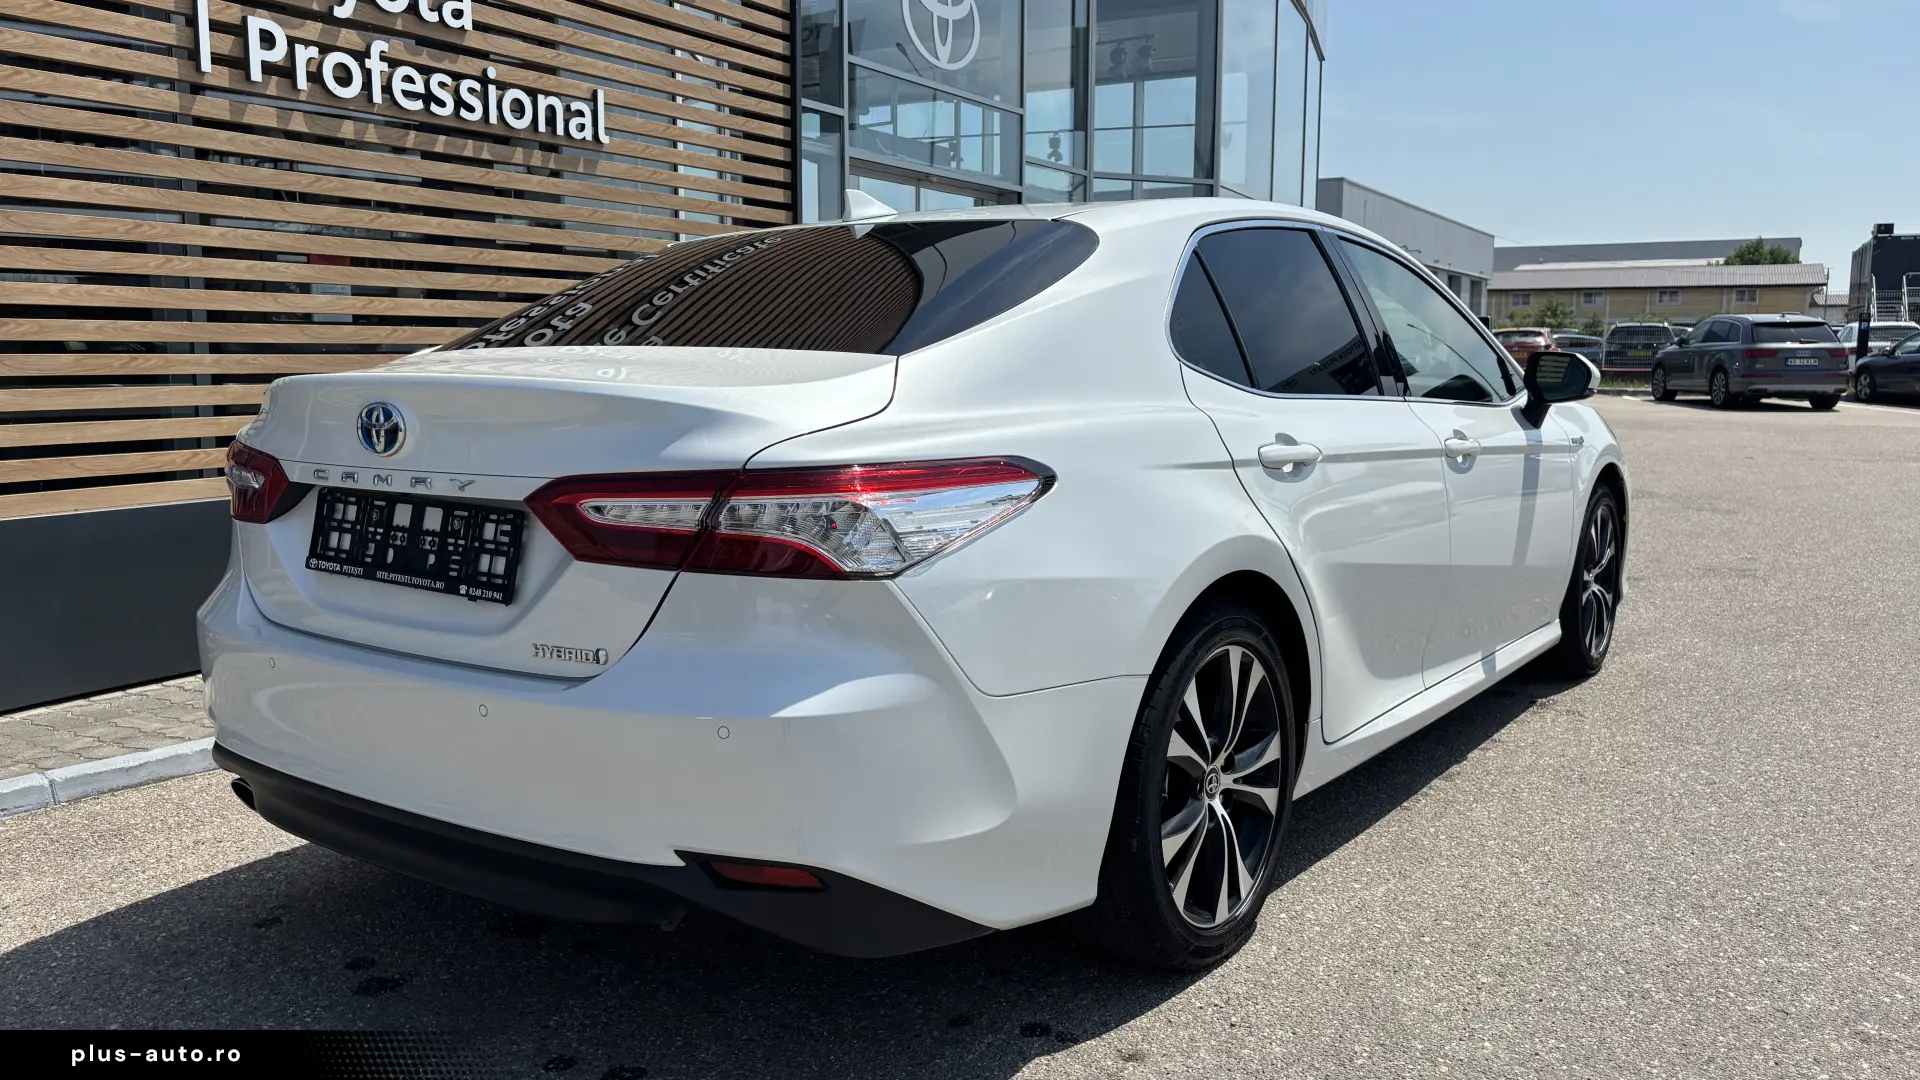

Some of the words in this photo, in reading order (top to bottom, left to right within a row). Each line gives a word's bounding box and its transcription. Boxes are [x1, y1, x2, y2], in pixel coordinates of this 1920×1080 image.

[246, 15, 609, 144] Professional
[313, 469, 476, 492] CAMRY
[318, 560, 341, 572] TOYOTA
[532, 643, 595, 664] HYBRID
